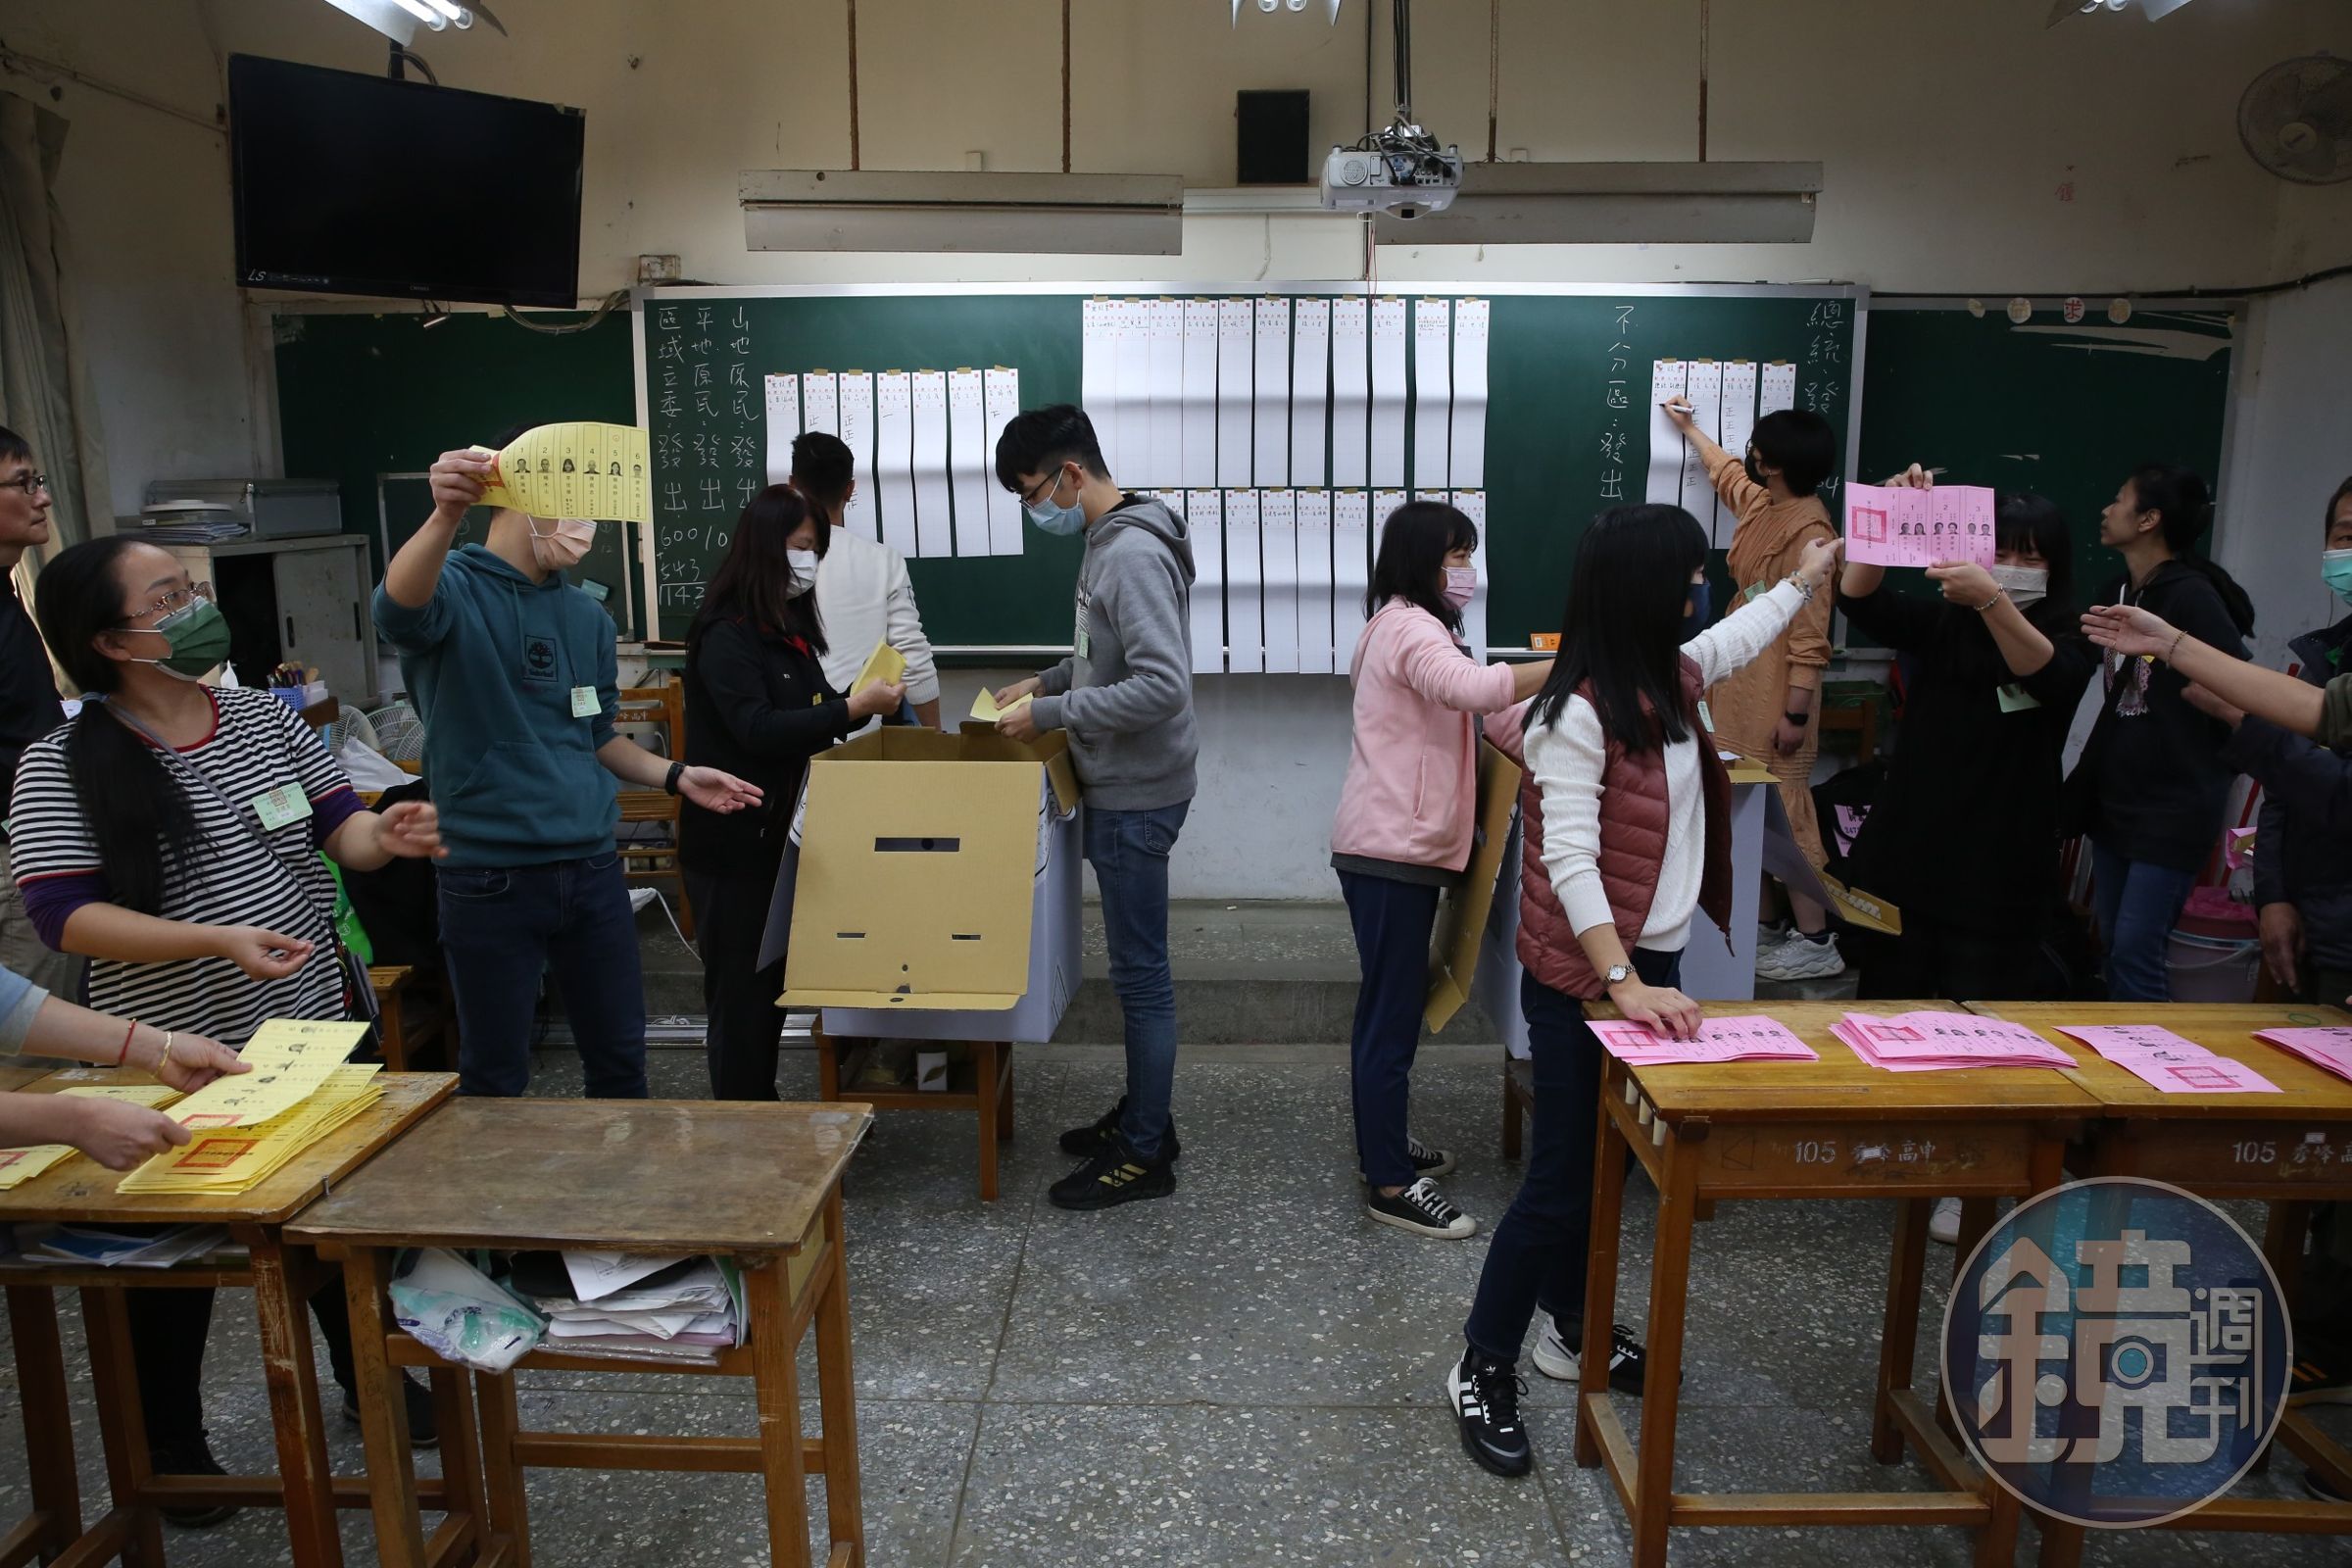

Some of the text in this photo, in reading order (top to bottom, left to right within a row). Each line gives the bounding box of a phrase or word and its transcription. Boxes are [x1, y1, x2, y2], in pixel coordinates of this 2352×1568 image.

[661, 526, 698, 547] 600
[661, 559, 700, 581] 543
[1795, 1141, 1837, 1163] 105
[2233, 1142, 2276, 1163] 105
